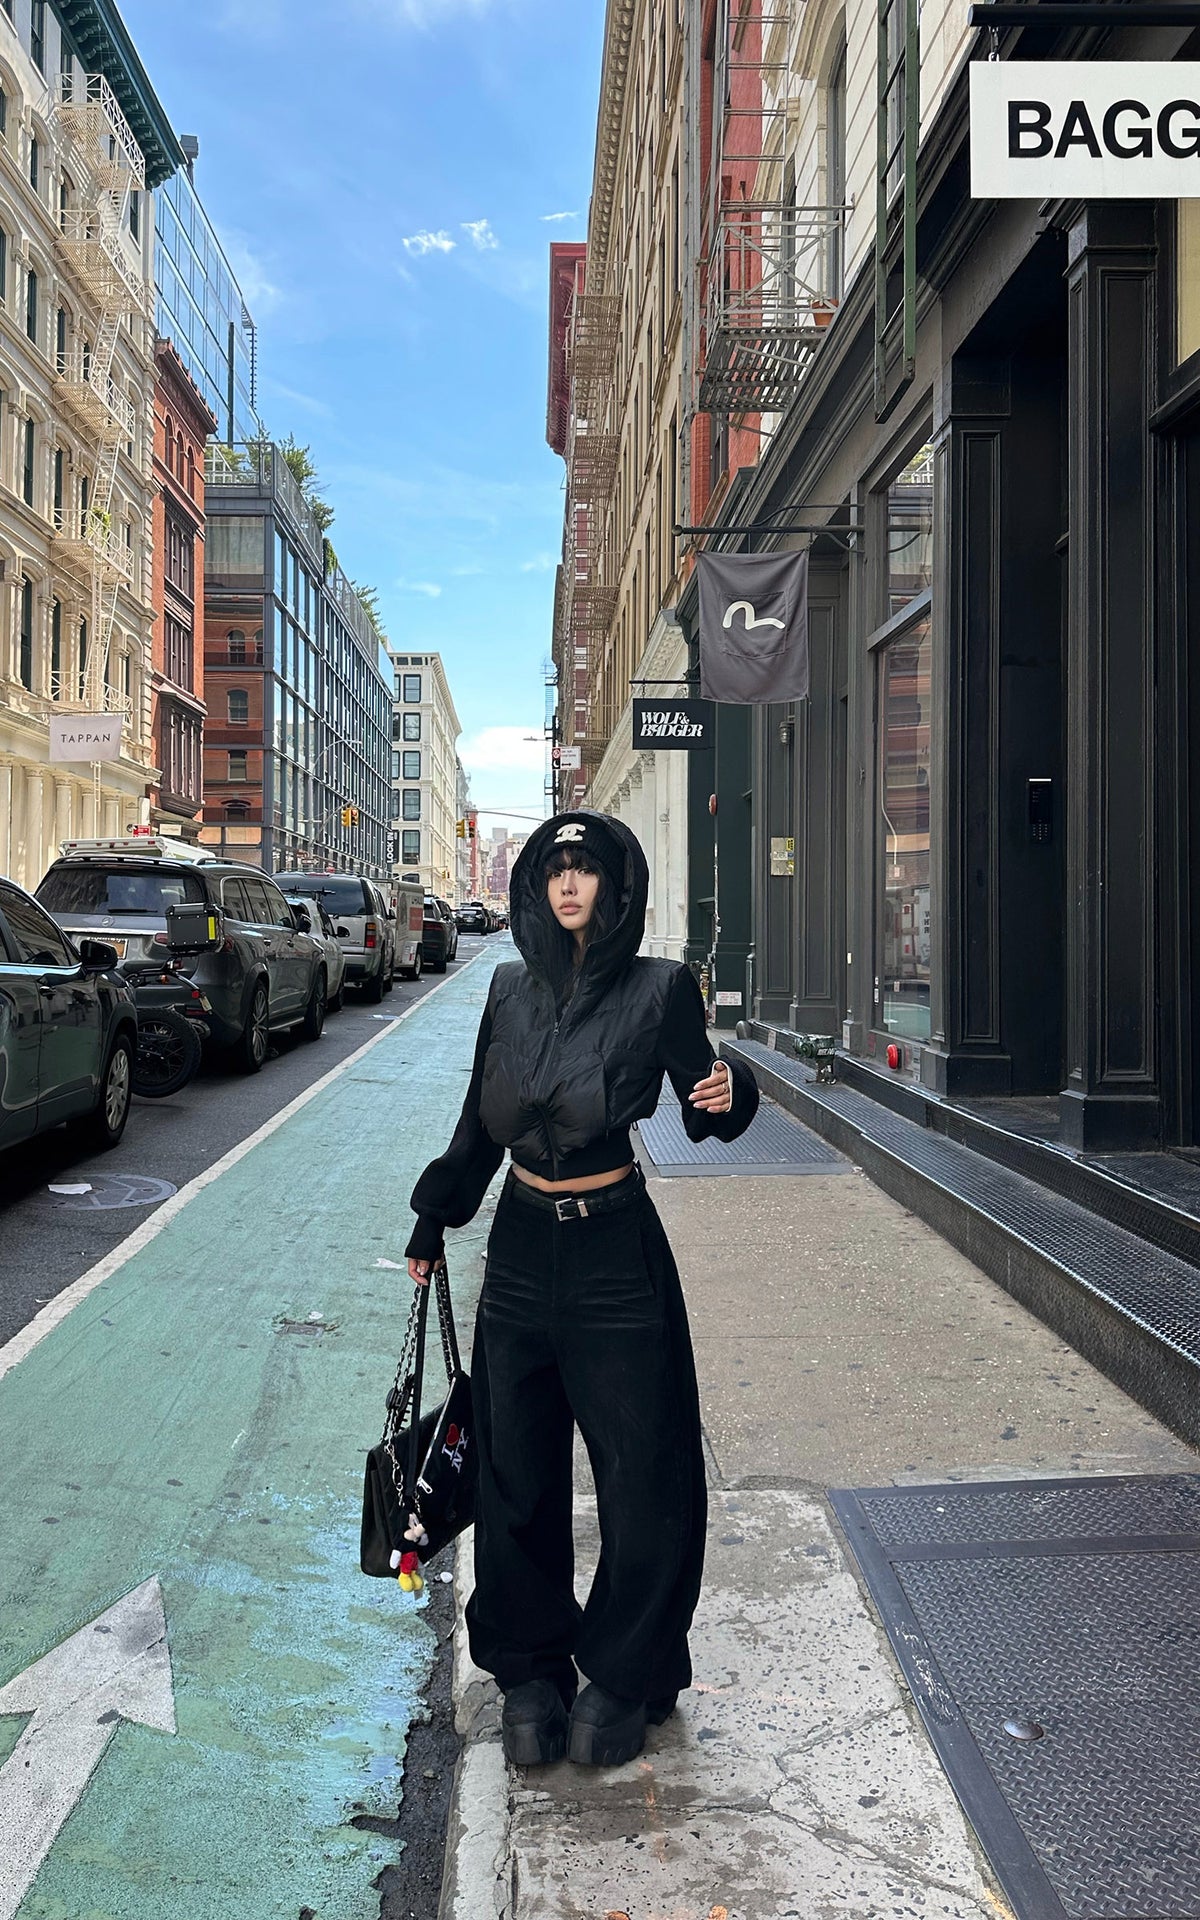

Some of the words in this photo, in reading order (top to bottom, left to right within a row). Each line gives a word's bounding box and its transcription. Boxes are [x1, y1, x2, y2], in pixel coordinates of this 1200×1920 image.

[61, 733, 111, 743] TAPPAN
[640, 724, 704, 737] BADGER
[386, 841, 394, 863] LOCK
[441, 1443, 455, 1460] I
[451, 1427, 469, 1473] NY
